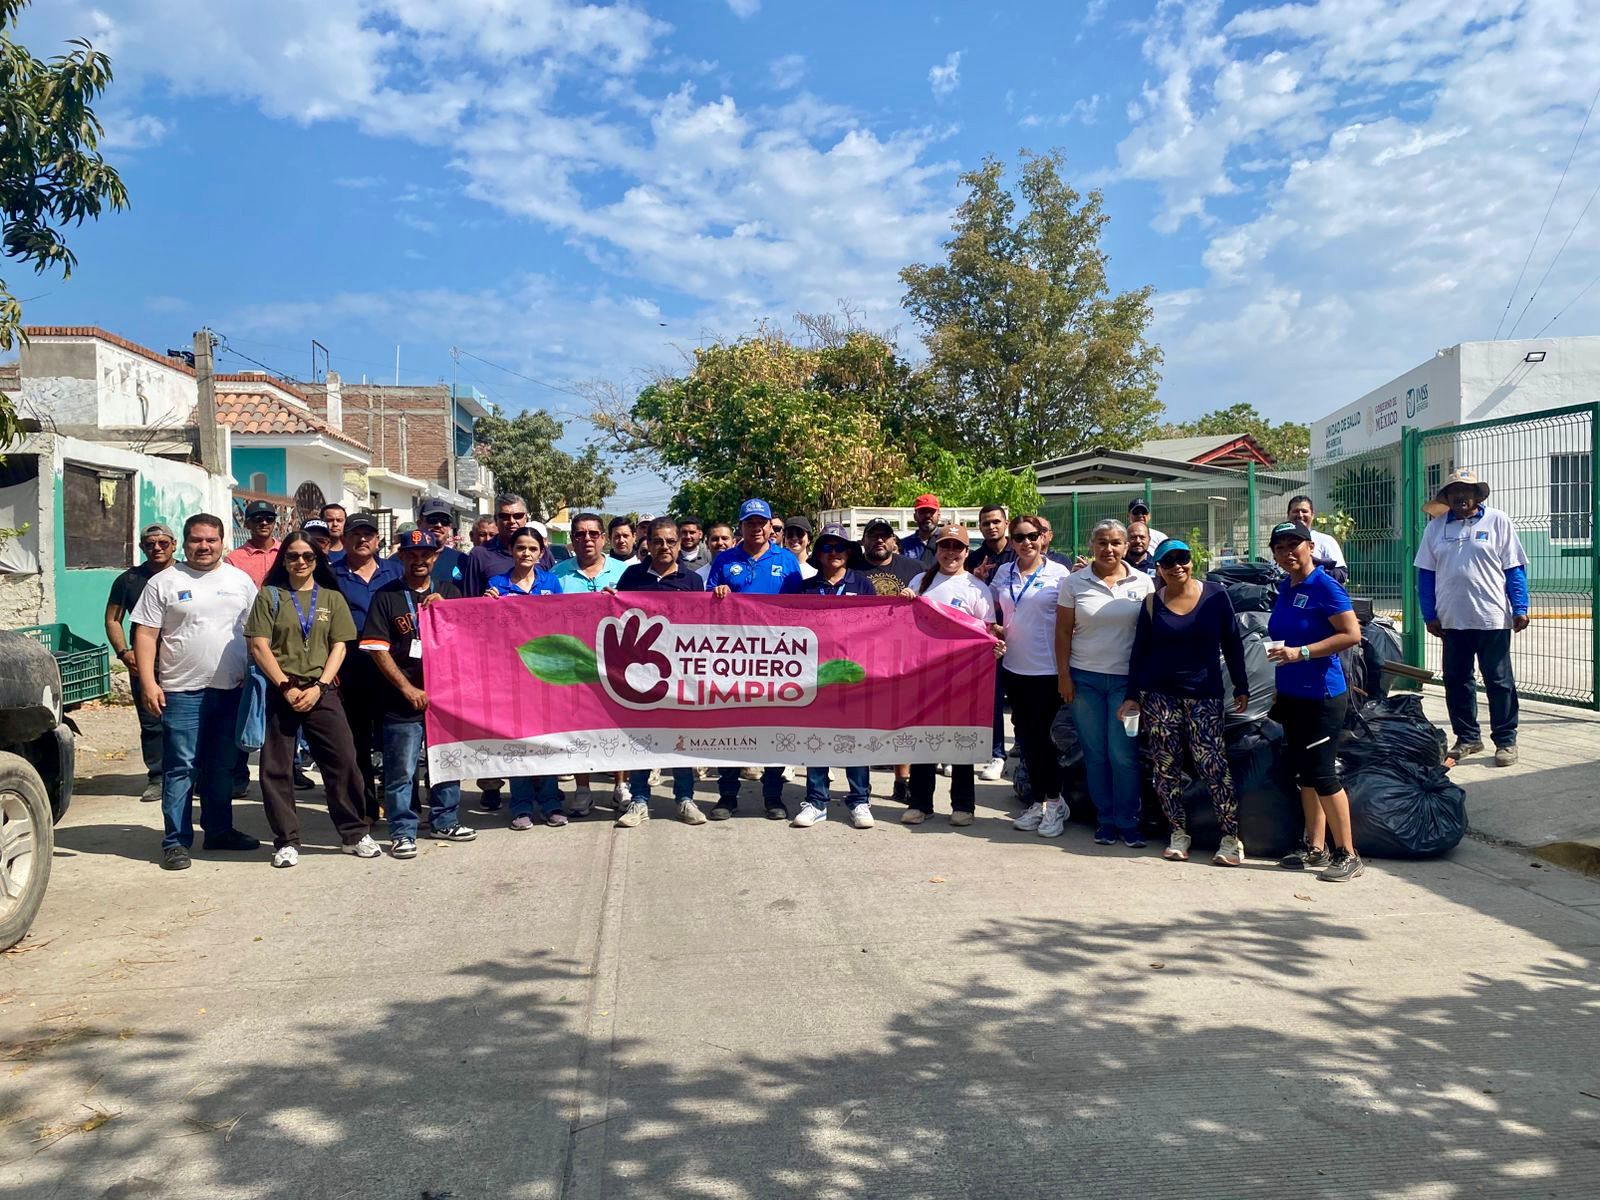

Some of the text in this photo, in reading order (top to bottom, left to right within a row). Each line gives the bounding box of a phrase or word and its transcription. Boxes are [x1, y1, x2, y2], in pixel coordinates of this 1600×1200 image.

[1376, 410, 1398, 431] MÉXICO
[675, 632, 807, 656] MAZATLÁN
[679, 658, 803, 677] TE QUIERO
[677, 680, 804, 705] LIMPIO
[690, 735, 757, 746] MAZATLÁN
